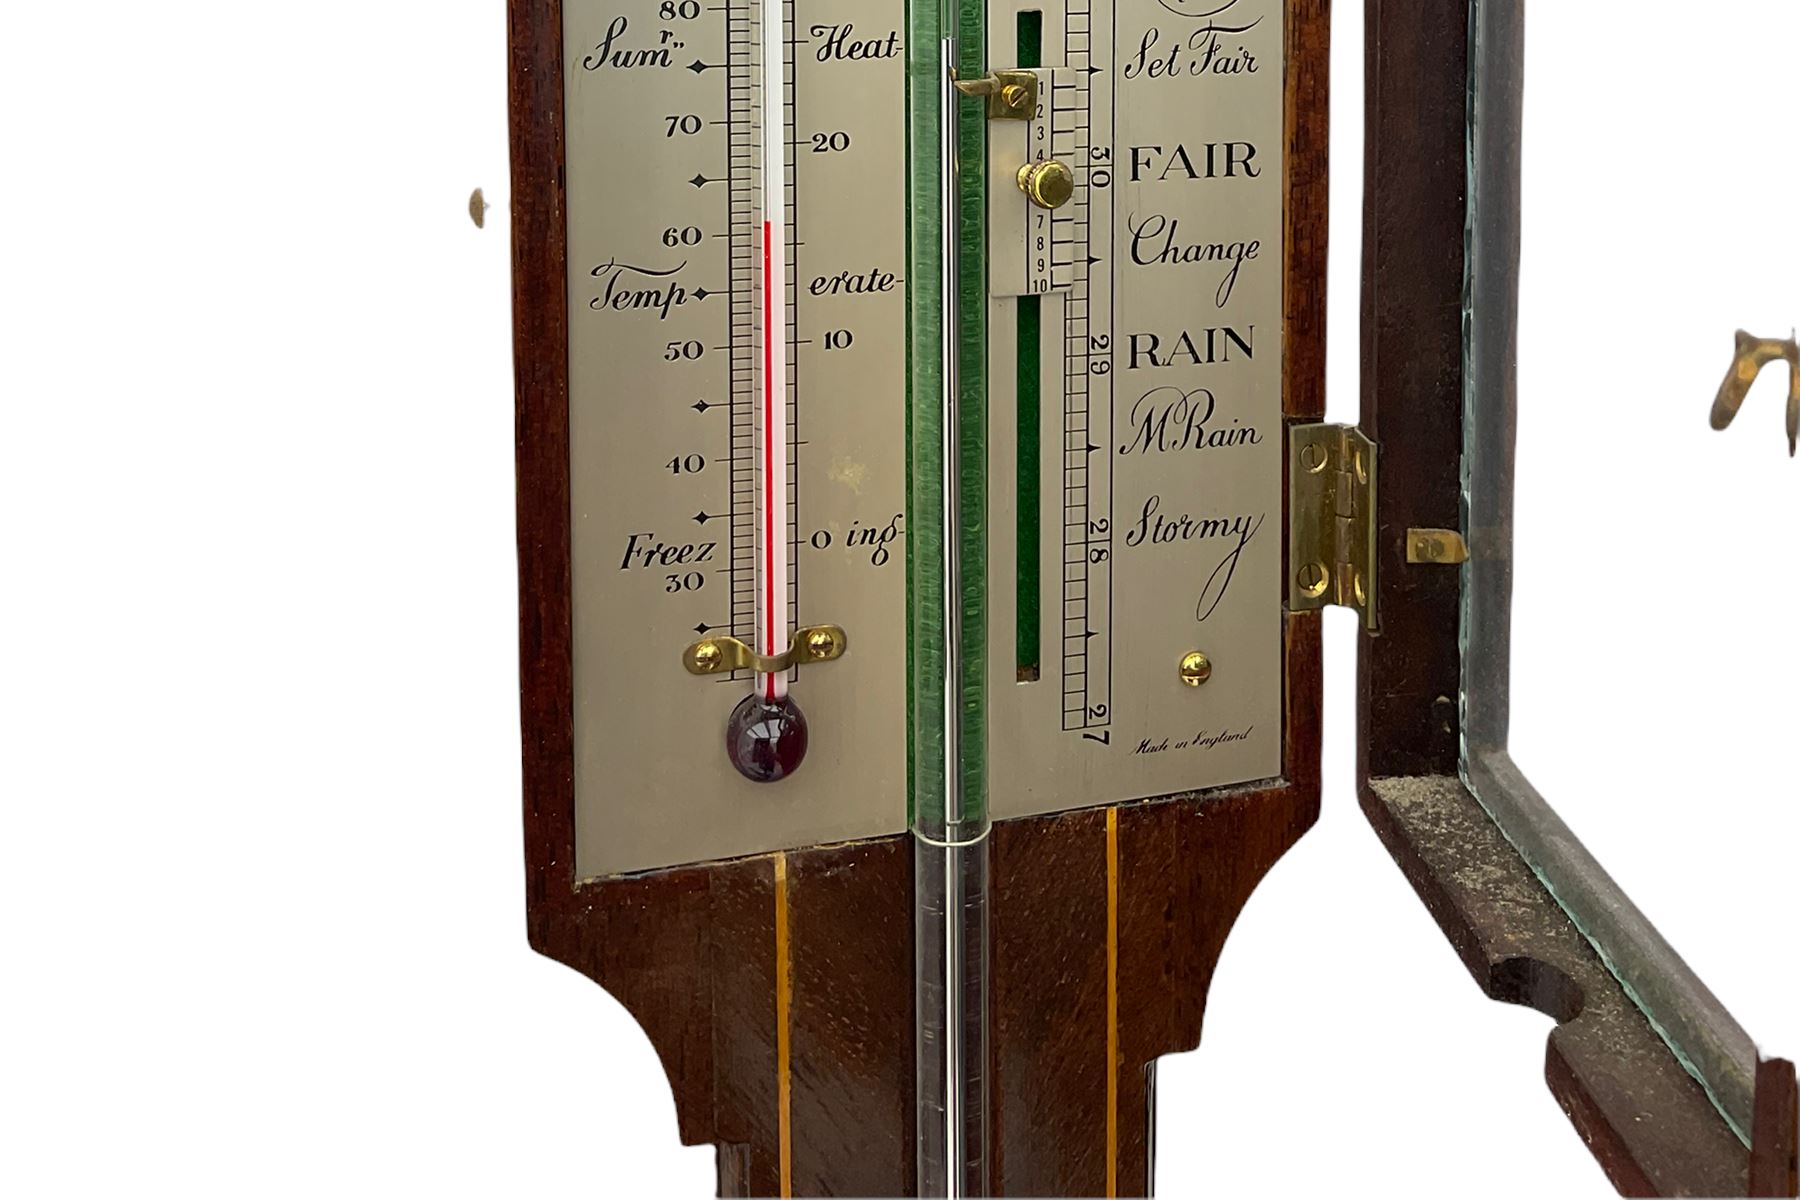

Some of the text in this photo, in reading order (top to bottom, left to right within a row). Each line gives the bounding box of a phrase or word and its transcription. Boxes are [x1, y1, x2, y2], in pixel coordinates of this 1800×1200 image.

[659, 0, 700, 20] 80
[1124, 18, 1264, 79] Set Fair
[1038, 80, 1045, 96] 1
[1036, 103, 1044, 119] 2
[664, 114, 702, 138] 70
[1036, 125, 1045, 141] 3
[811, 131, 850, 153] 20
[1036, 149, 1044, 161] 4
[1128, 141, 1262, 183] FAIR
[1036, 214, 1045, 230] 7
[662, 225, 702, 247] 60
[1036, 236, 1045, 251] 8
[1036, 258, 1045, 273] 9
[1128, 210, 1261, 308] Change
[589, 256, 688, 320] Temp
[1032, 279, 1048, 294] 10
[824, 328, 853, 350] 10
[1126, 325, 1256, 370] RAIN
[663, 340, 704, 361] 50
[665, 453, 705, 474] 40
[619, 532, 717, 571] Freez
[1125, 495, 1266, 622] Stormy
[665, 571, 705, 594] 30
[1130, 725, 1254, 755] Made in England
